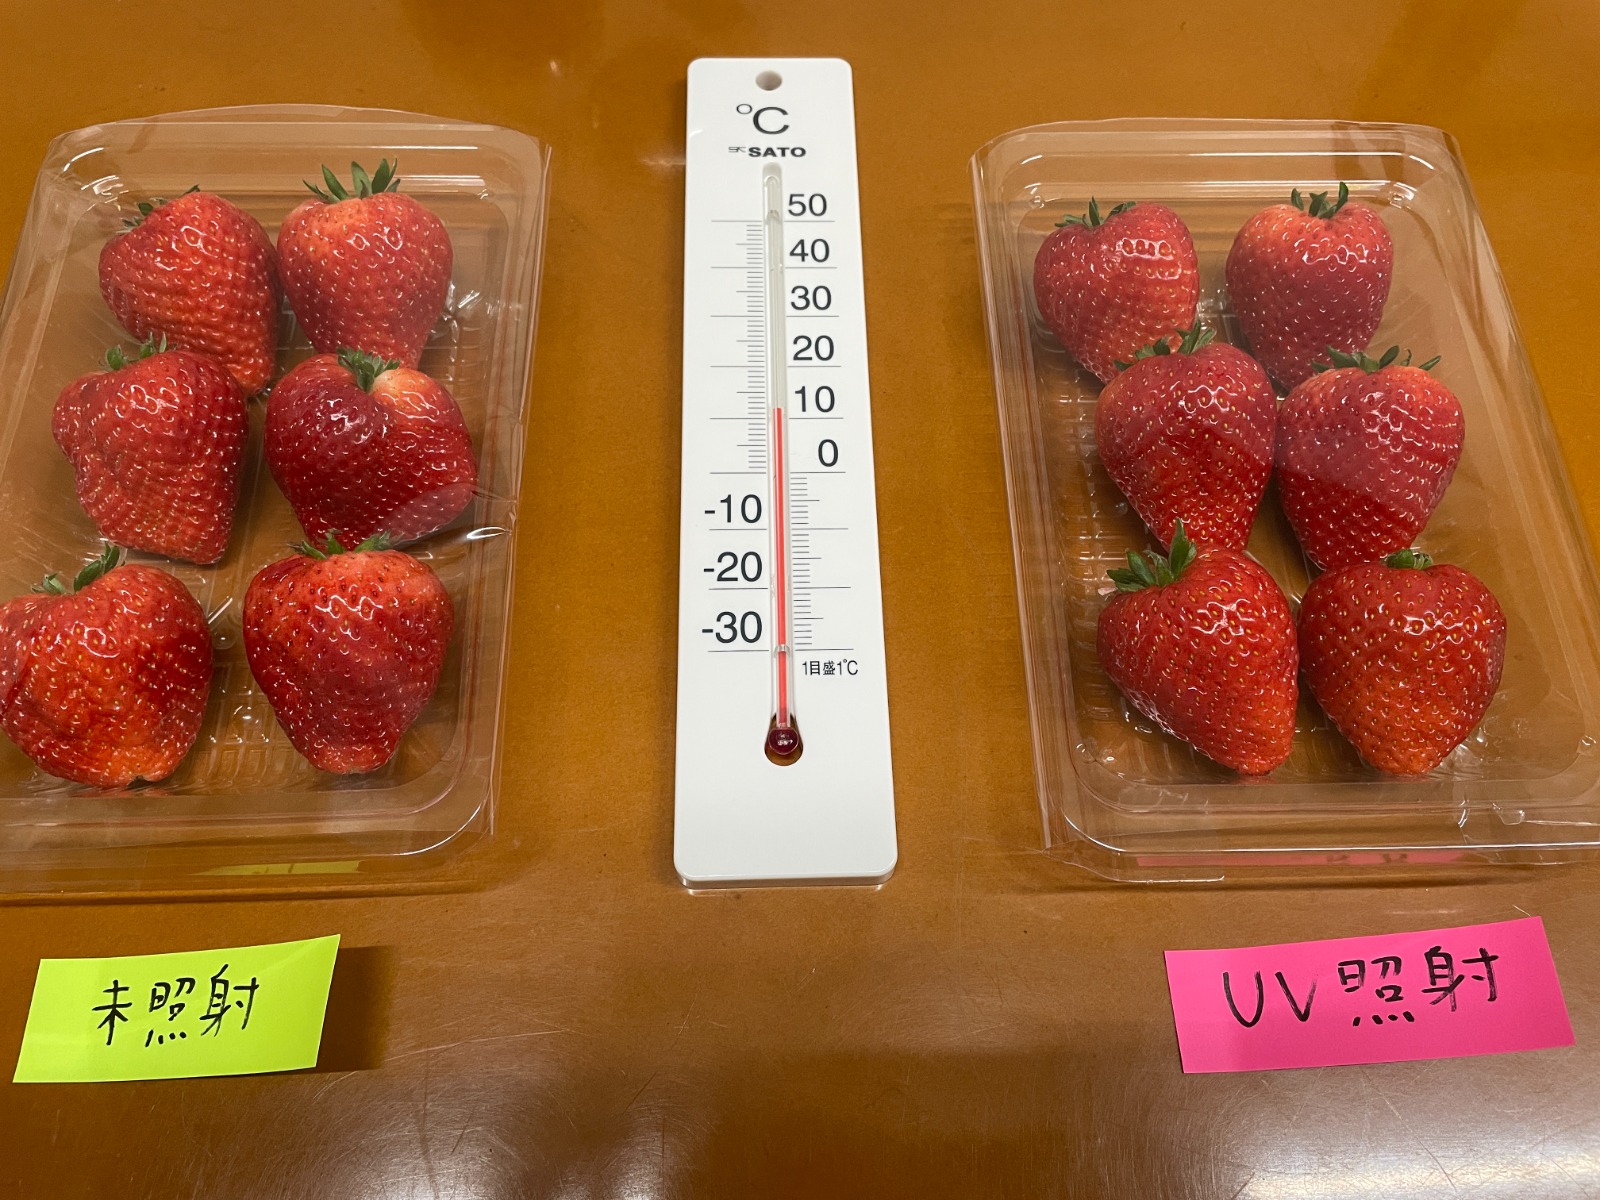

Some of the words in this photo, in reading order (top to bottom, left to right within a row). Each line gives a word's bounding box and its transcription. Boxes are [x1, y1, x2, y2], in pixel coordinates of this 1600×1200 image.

[748, 146, 806, 158] SATO
[787, 193, 828, 217] 50
[789, 238, 830, 263] 40
[790, 285, 832, 311] 30
[792, 335, 835, 361] 20
[794, 385, 836, 413] 10
[817, 438, 839, 467] 0
[704, 494, 762, 523] -10
[703, 551, 763, 582] -20
[701, 611, 763, 643] -30
[91, 963, 260, 1048] 未照射
